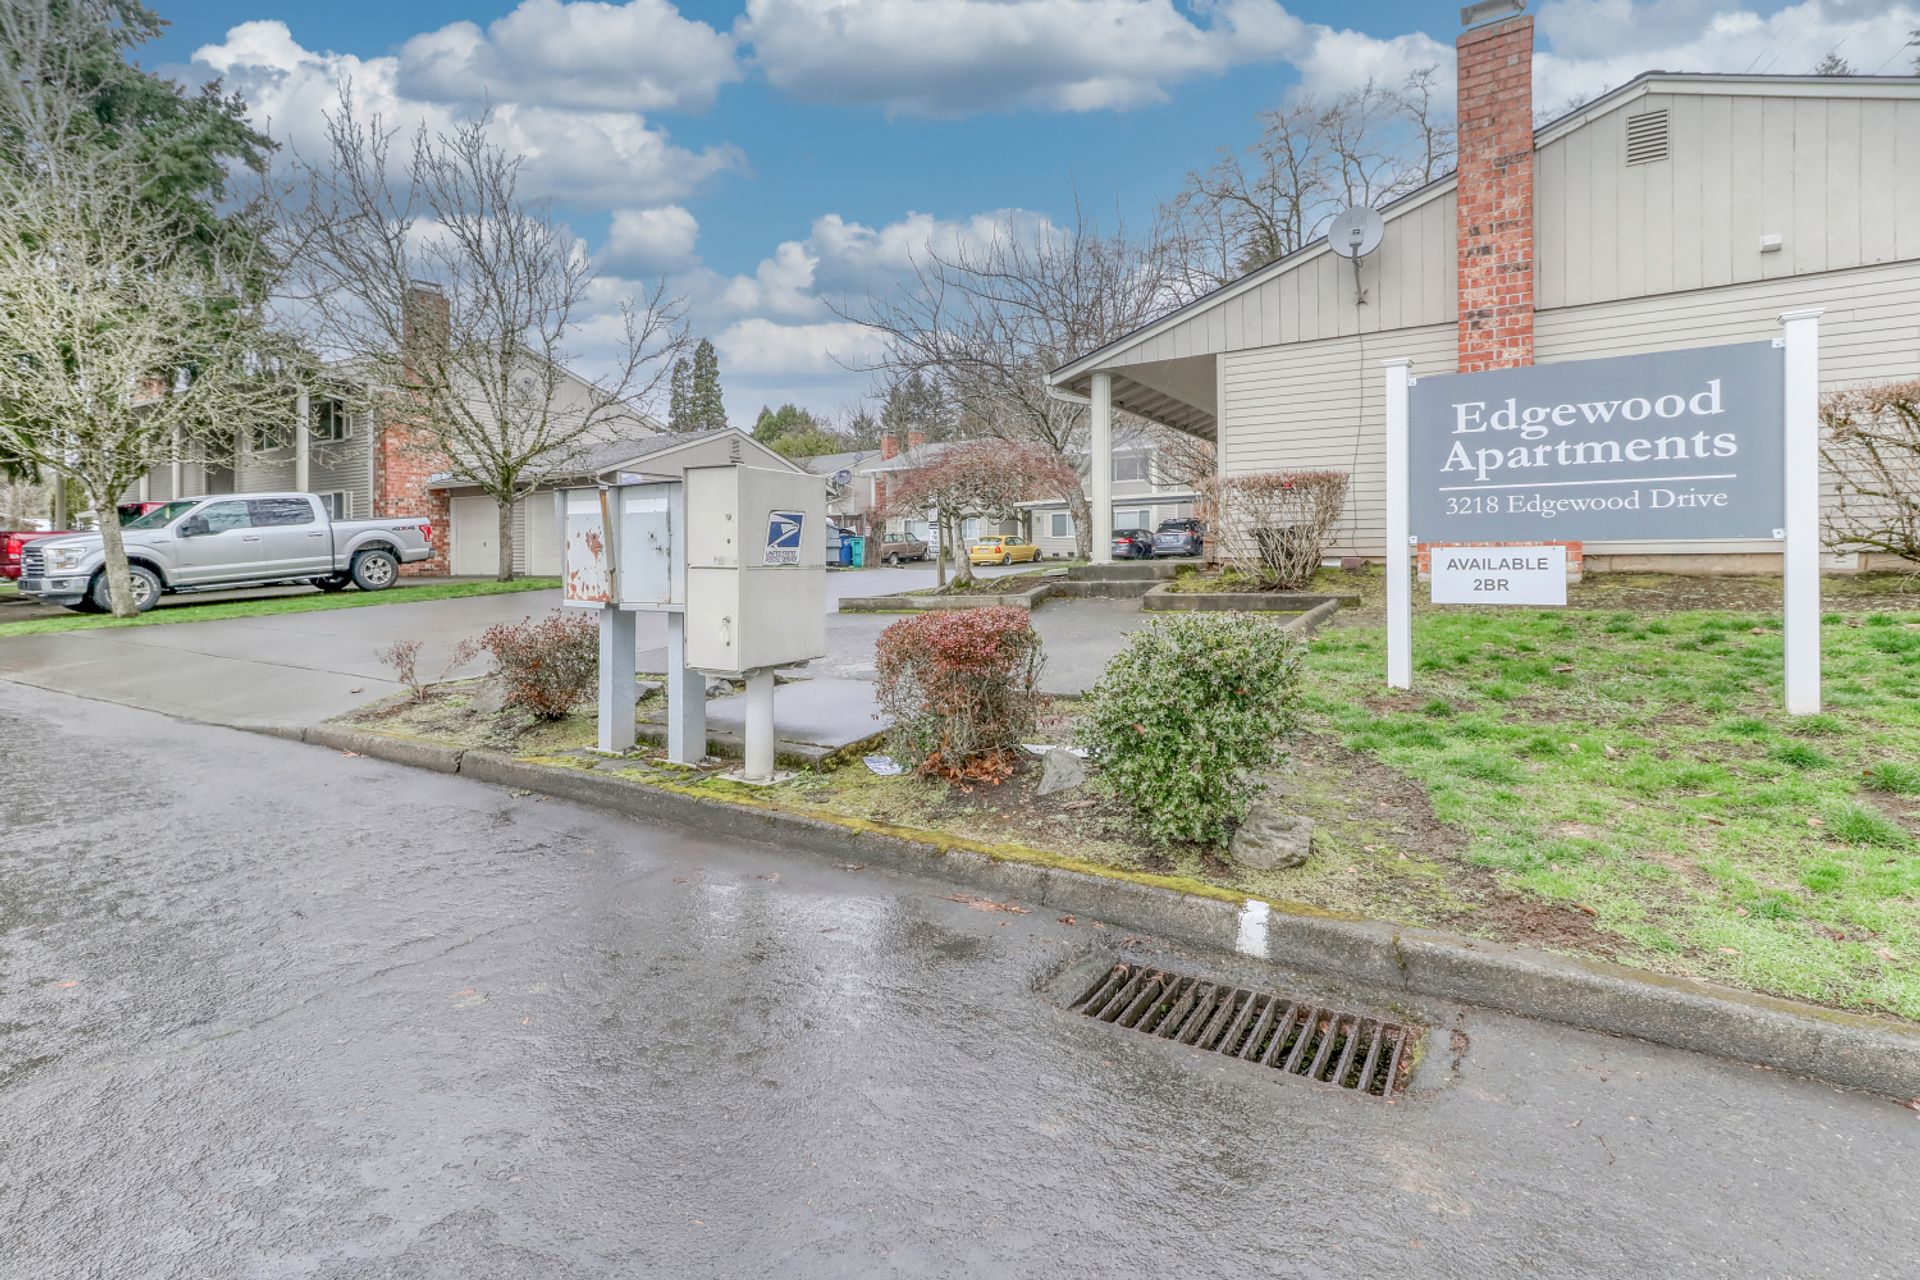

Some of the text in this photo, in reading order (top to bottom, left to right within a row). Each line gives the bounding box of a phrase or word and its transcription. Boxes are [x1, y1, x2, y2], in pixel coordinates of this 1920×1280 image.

[1451, 378, 1726, 441] Edgewood
[1439, 430, 1739, 482] Apartments
[1446, 486, 1729, 519] 3218 Edgewood Drive
[1446, 557, 1549, 571] AVAILABLE
[1473, 578, 1510, 592] 2BR
